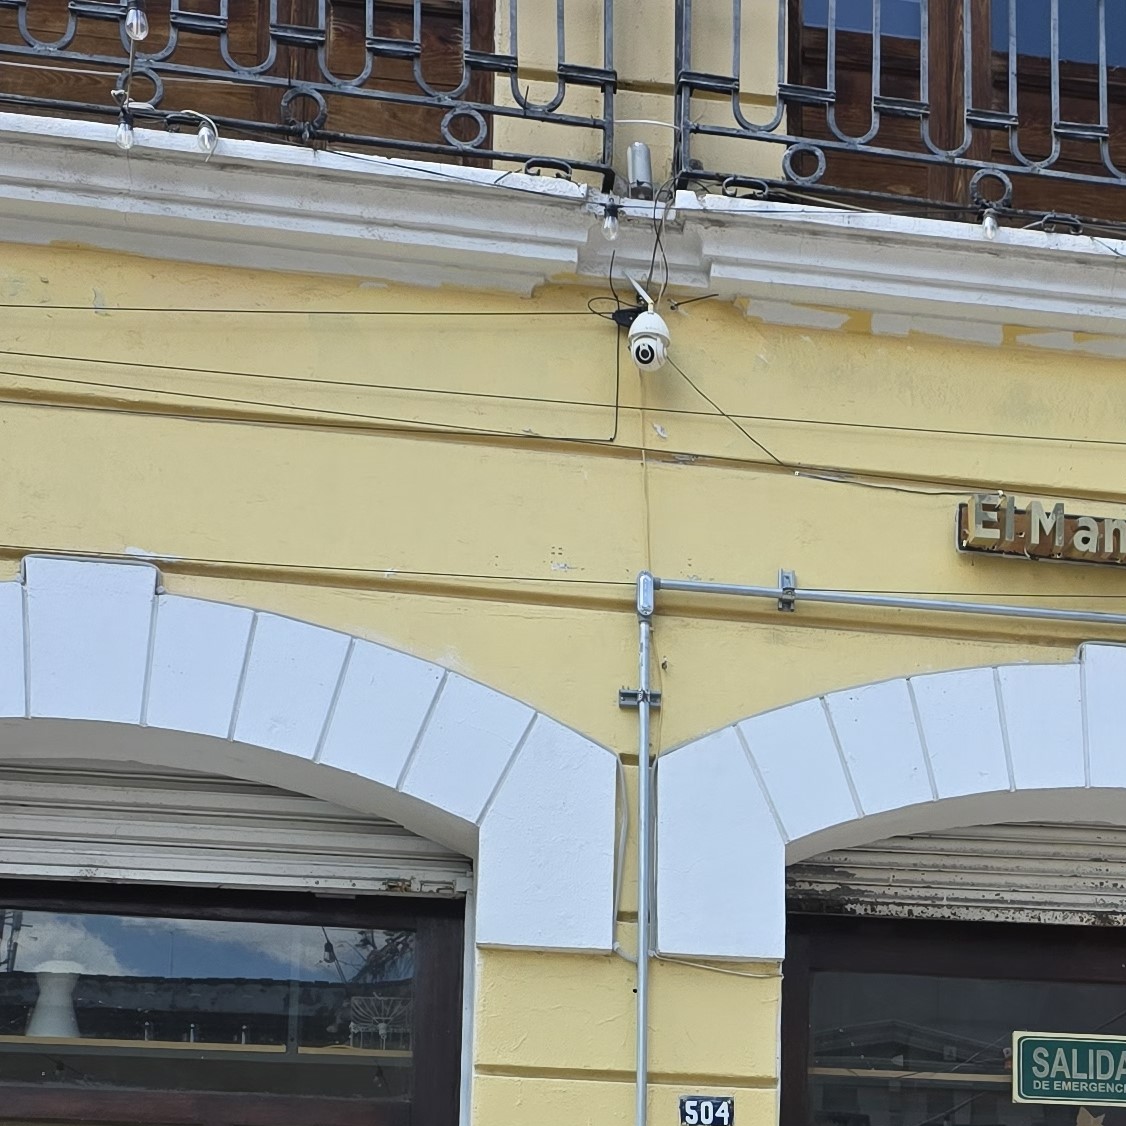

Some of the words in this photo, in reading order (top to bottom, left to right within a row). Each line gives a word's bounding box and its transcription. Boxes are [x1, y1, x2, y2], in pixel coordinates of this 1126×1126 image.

[969, 495, 1015, 543] El
[1033, 1080, 1050, 1091] DE
[685, 1100, 730, 1126] 504
